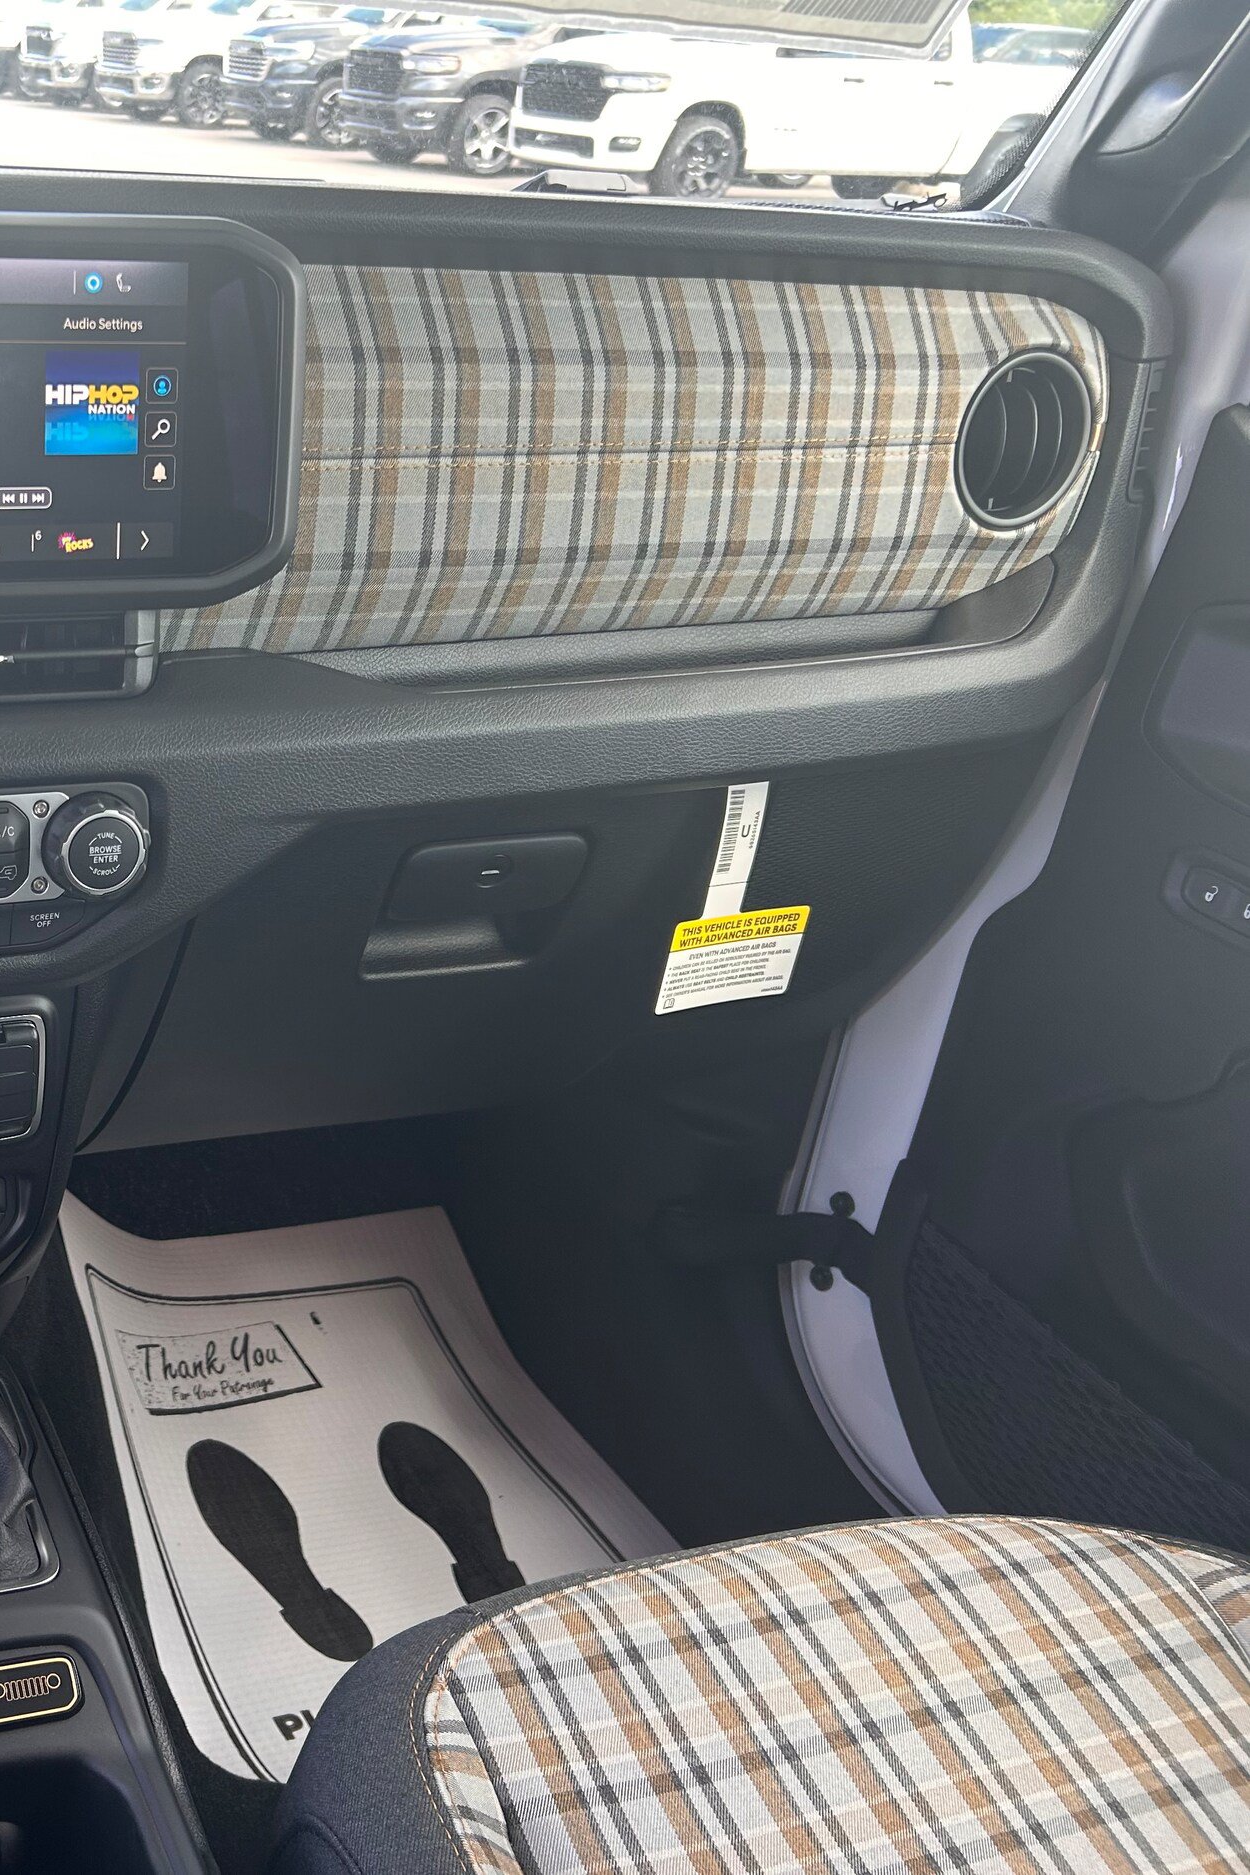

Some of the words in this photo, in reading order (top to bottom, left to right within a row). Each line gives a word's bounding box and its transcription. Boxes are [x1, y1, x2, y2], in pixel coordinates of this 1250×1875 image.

[63, 318, 96, 330] Audio
[98, 319, 143, 333] Settings
[88, 404, 136, 415] NATION
[34, 530, 42, 541] 6
[65, 538, 94, 553] ROCKS
[97, 832, 115, 840] TUNE
[89, 845, 122, 854] BROWSE
[93, 855, 119, 864] ENTER
[92, 866, 118, 876] SCROLL
[30, 912, 61, 922] SCREEN
[36, 920, 52, 929] OFF
[682, 926, 702, 937] THIS
[705, 921, 741, 934] VEHICLE
[744, 918, 753, 927] IS
[755, 913, 800, 926] EQUIPPED
[679, 938, 702, 948] WITH
[704, 930, 754, 944] ADVANCED
[756, 926, 771, 936] AIR
[772, 923, 798, 933] BAGS
[705, 950, 720, 958] WITH
[720, 945, 750, 954] ADVANCED
[761, 942, 776, 950] BAGS
[136, 1340, 224, 1382] Thank
[230, 1332, 283, 1373] You
[172, 1388, 191, 1402] For
[192, 1385, 218, 1400] Your
[220, 1377, 276, 1398] Patronage
